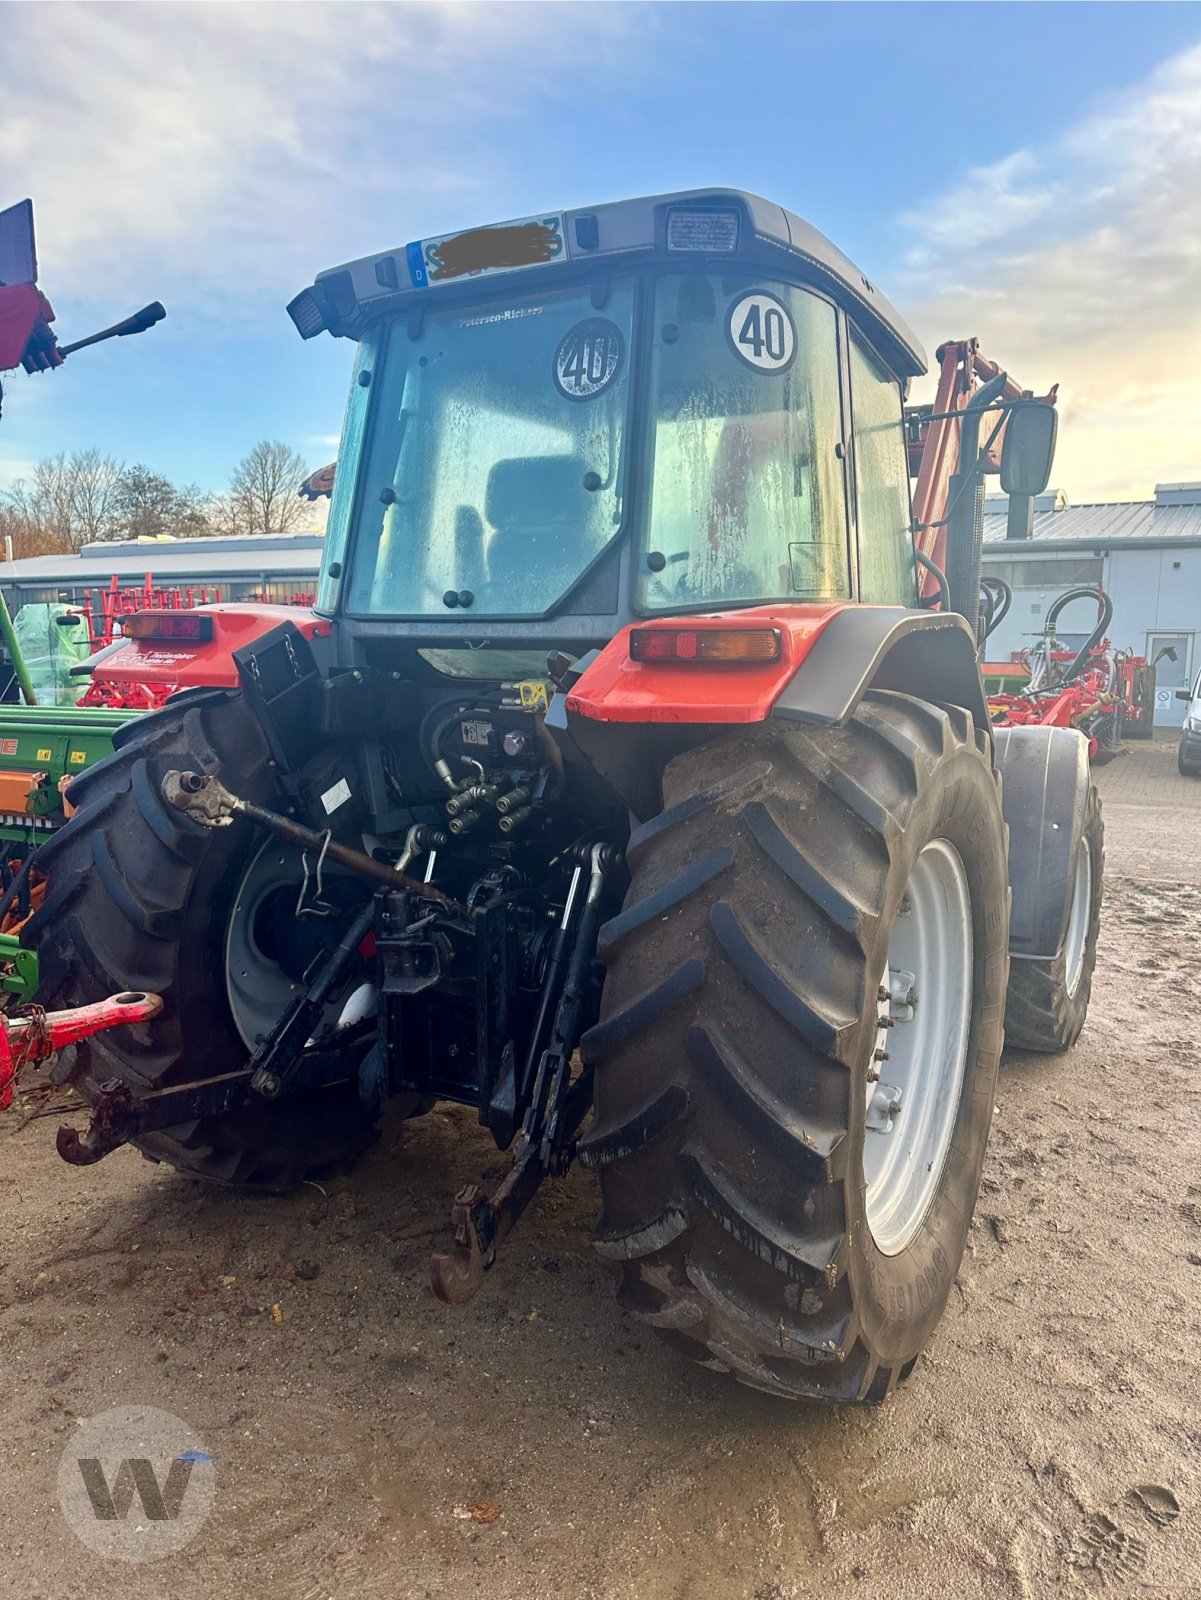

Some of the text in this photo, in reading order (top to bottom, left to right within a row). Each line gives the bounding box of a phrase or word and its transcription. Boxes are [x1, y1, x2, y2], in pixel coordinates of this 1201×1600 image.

[460, 306, 544, 328] Petersen-Rickers
[736, 303, 786, 361] 40
[562, 337, 610, 388] 40
